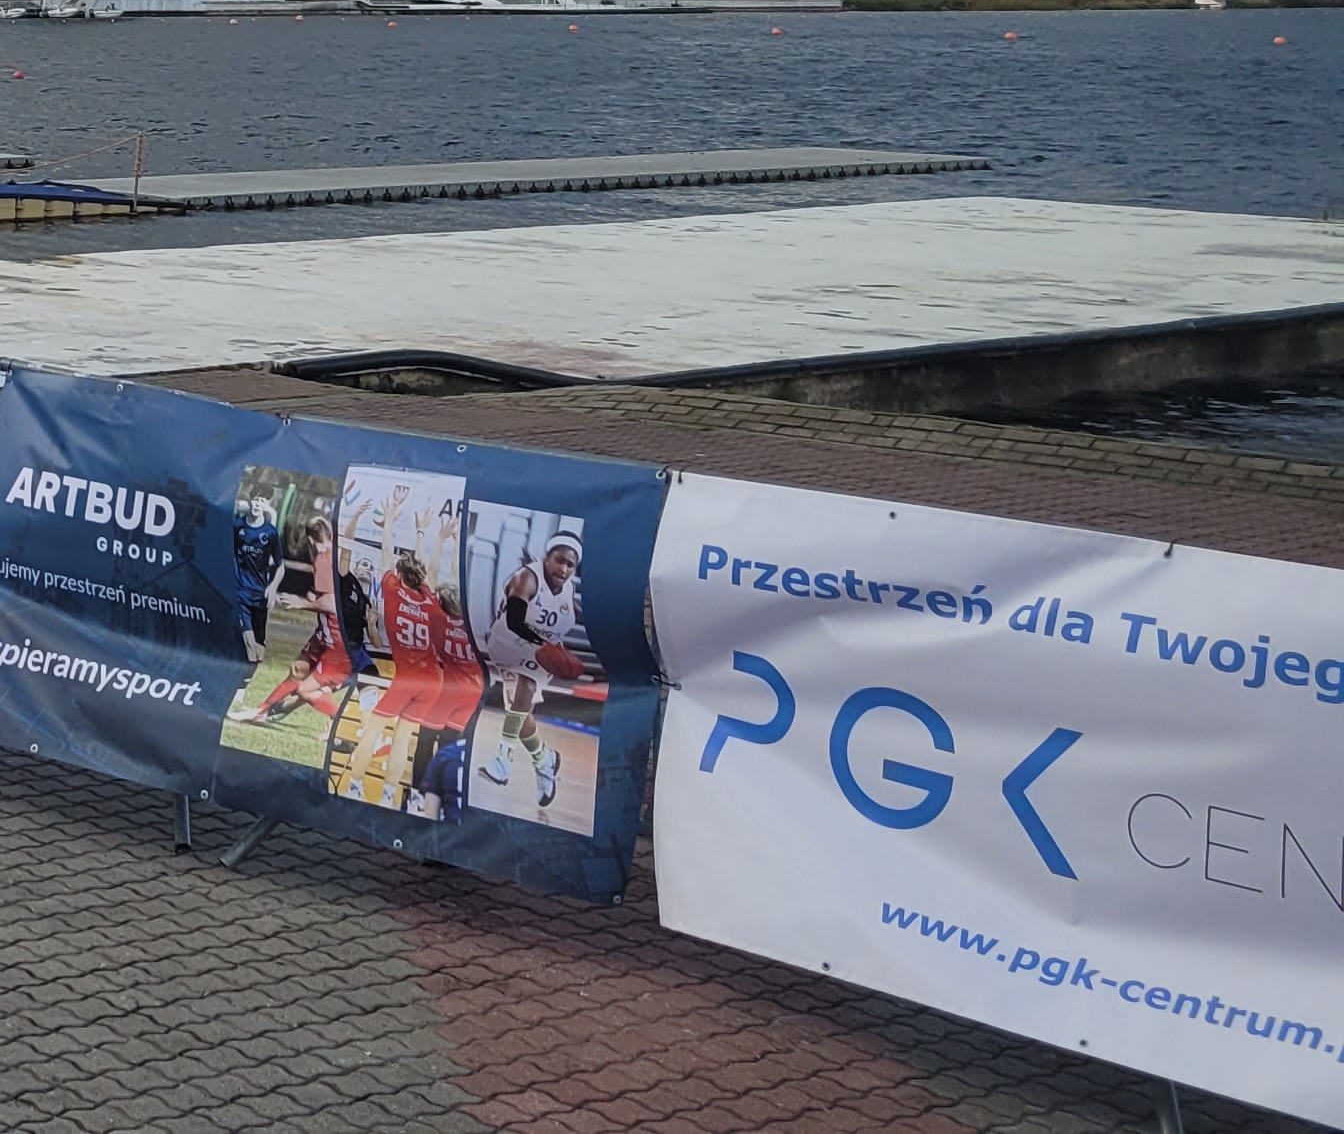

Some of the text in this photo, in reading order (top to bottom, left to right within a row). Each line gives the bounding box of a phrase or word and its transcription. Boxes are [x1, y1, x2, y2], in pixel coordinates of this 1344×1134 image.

[5, 466, 177, 538] ARTBUD
[96, 536, 173, 567] GROUP
[44, 571, 126, 605] przestrzeń
[130, 591, 212, 624] premium.
[534, 608, 558, 627] 30
[696, 543, 1344, 705] Przestrzeń dla Twojeg
[395, 616, 430, 651] 39
[698, 650, 1344, 913] PGK CEN
[880, 901, 1344, 1065] www.pgk-centrum.
